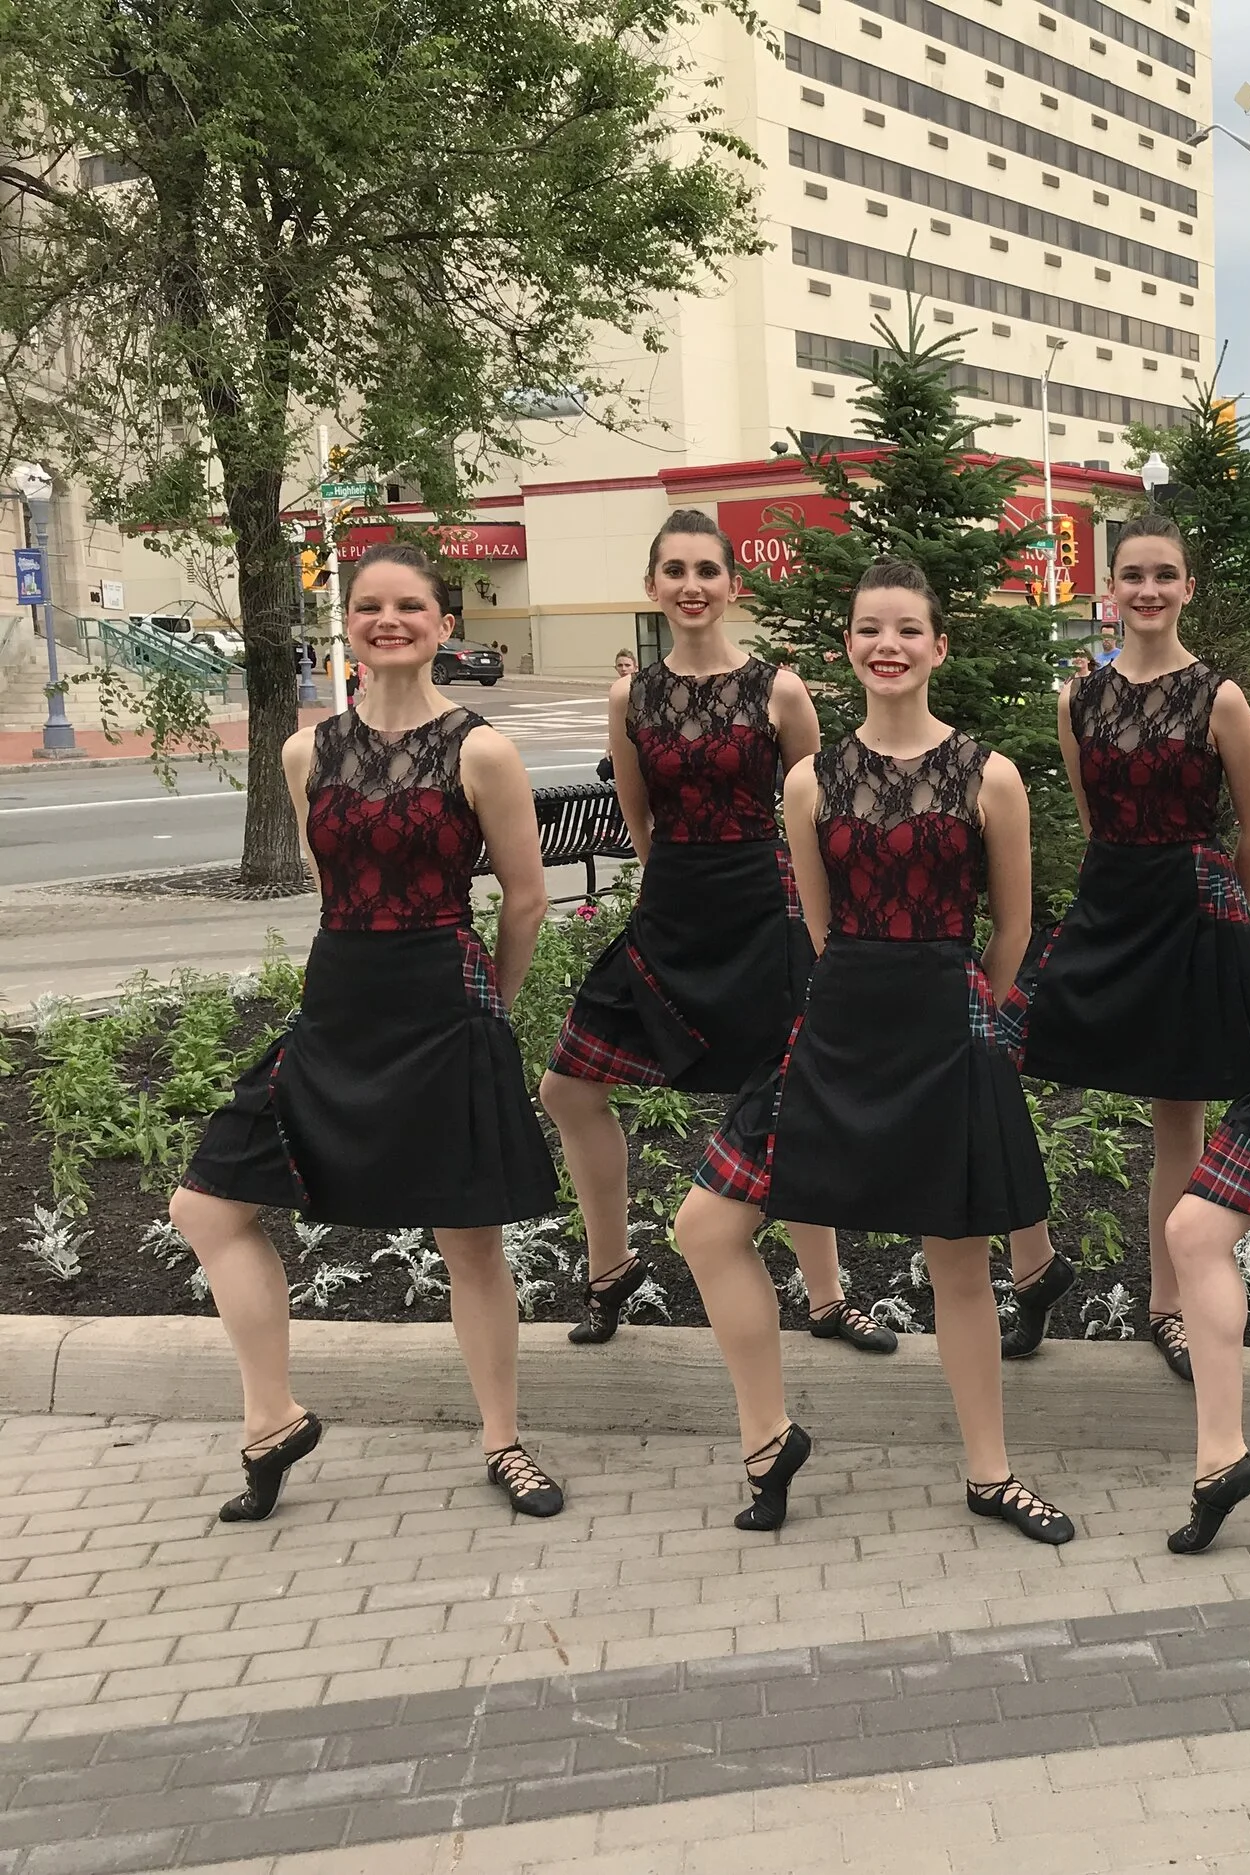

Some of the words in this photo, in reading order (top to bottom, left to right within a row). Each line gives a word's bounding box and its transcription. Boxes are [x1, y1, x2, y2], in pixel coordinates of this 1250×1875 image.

[439, 544, 469, 555] WNE
[475, 544, 519, 555] PLAZA
[741, 537, 799, 563] CROW
